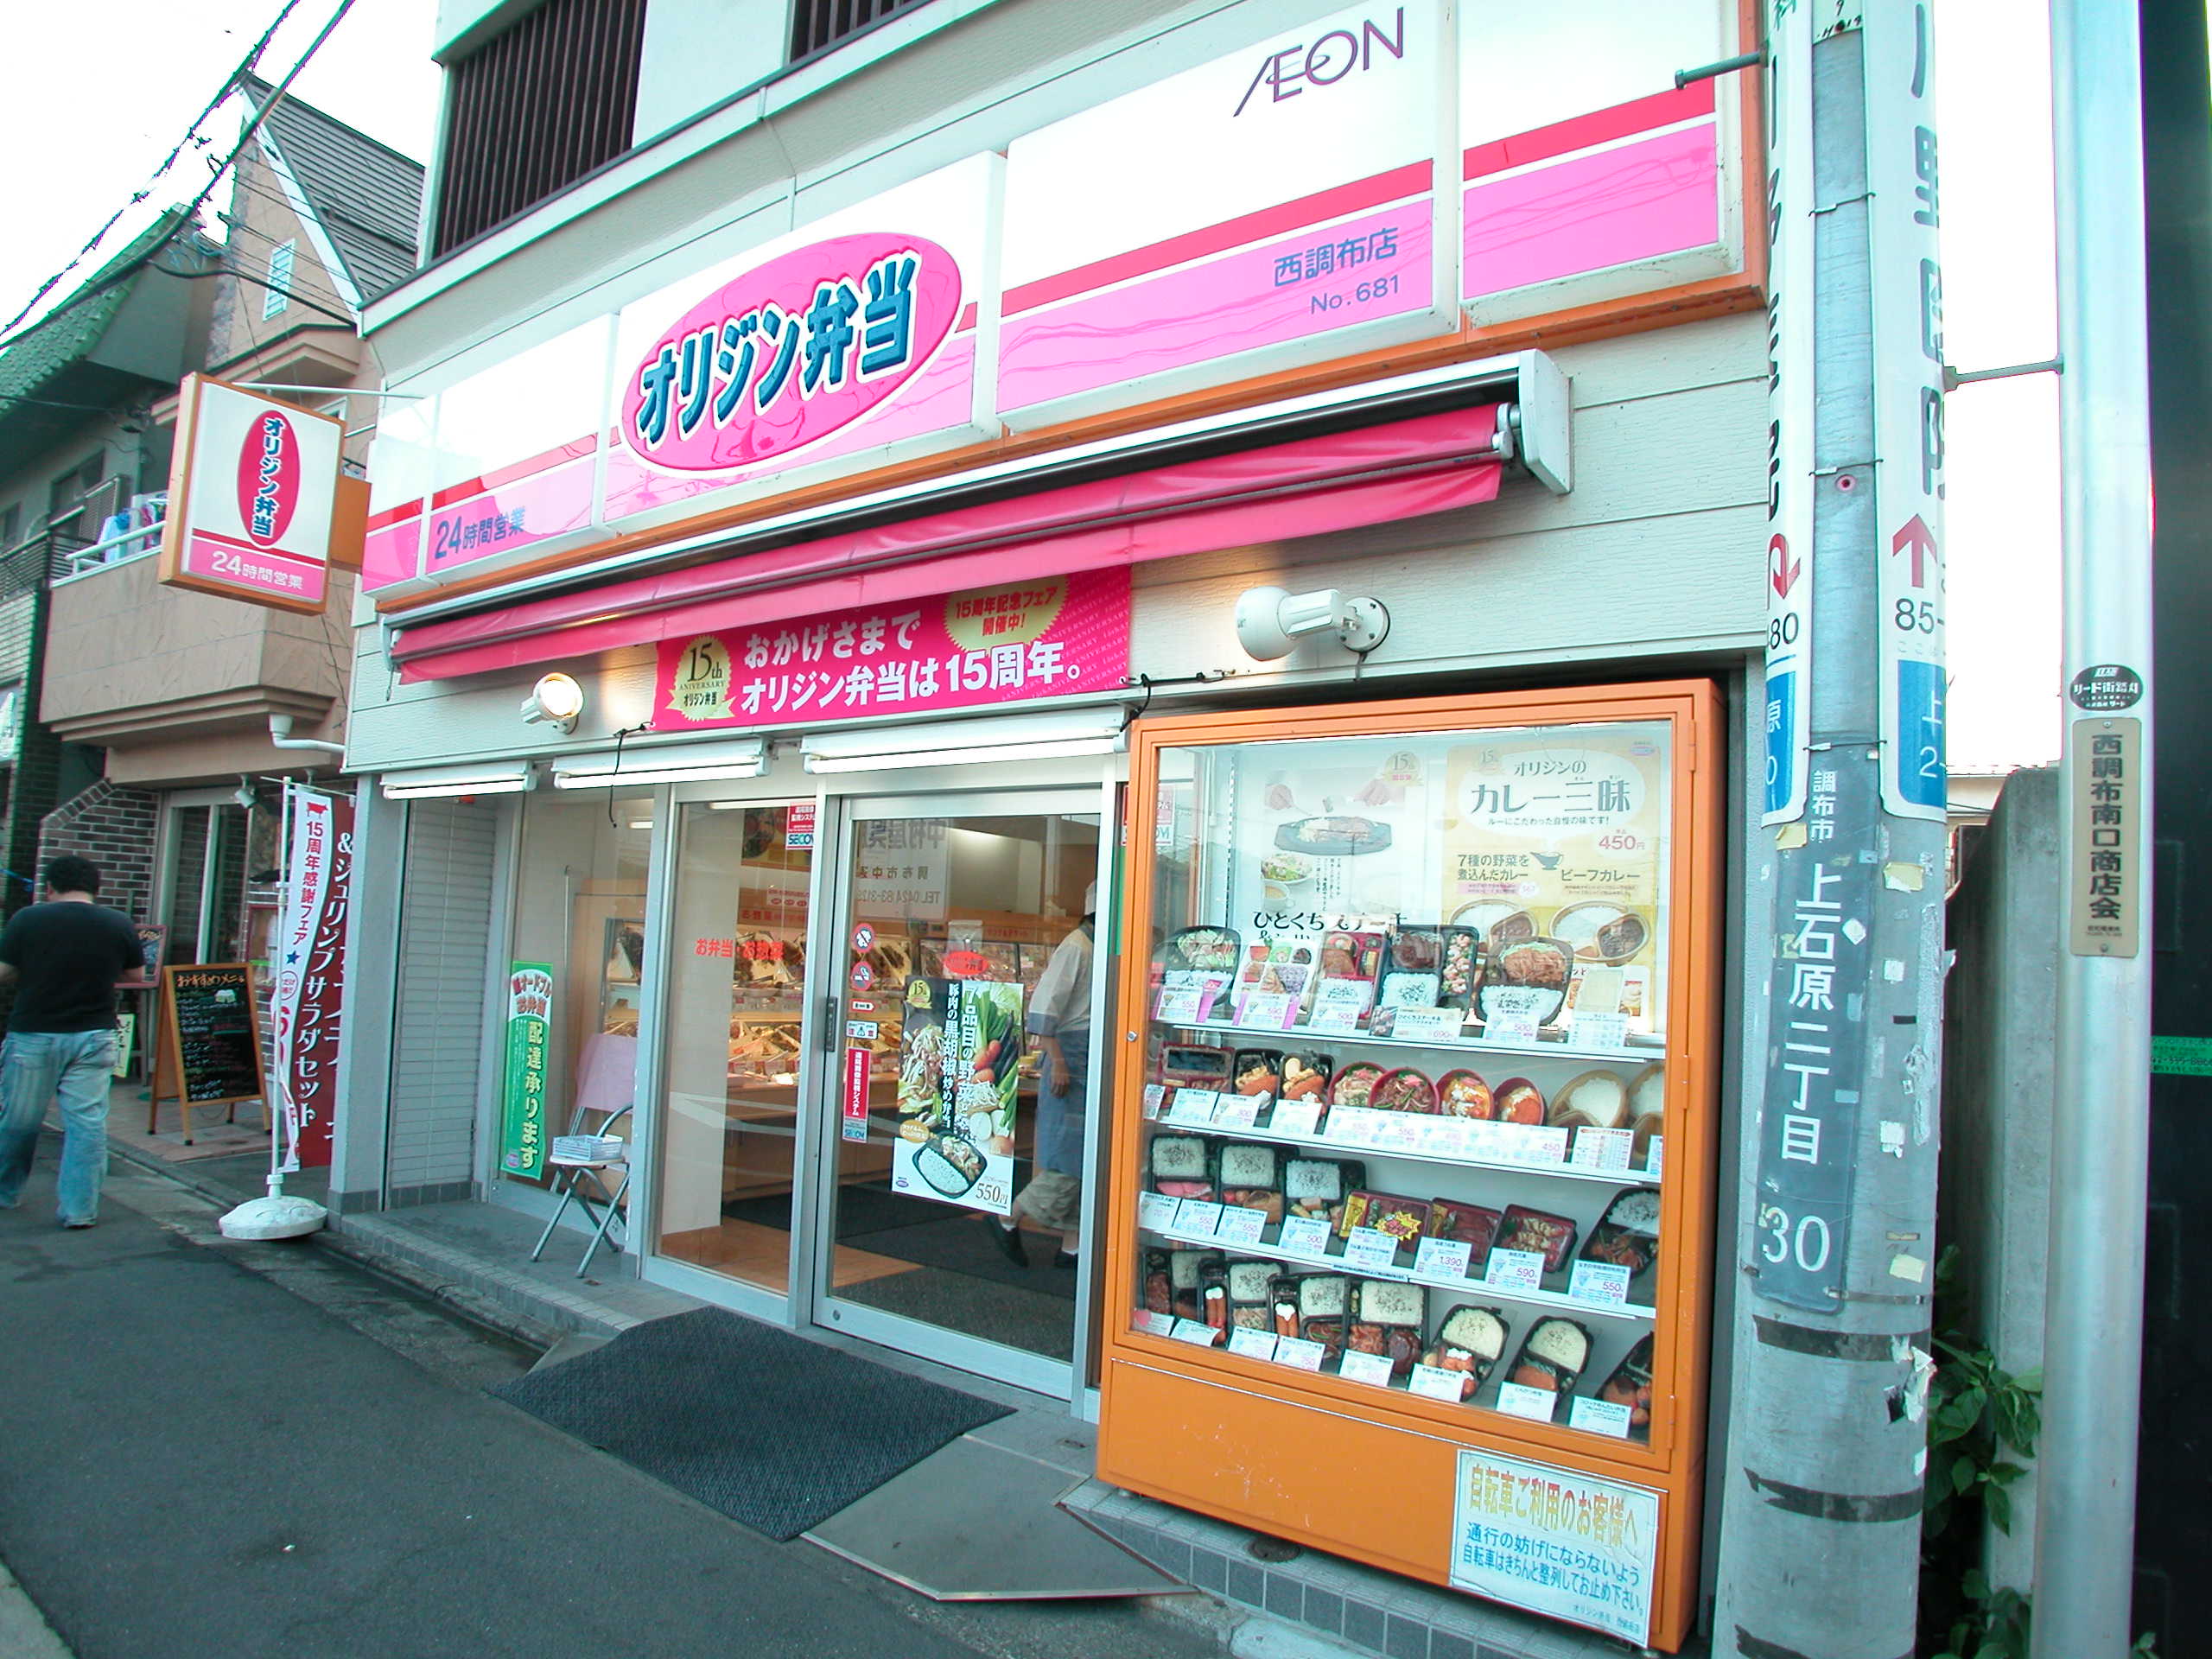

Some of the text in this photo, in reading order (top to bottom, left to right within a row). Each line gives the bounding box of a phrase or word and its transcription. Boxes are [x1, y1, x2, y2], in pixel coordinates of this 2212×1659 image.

[1274, 227, 1398, 287] 西調布店
[638, 257, 917, 445] オリジン弁当
[252, 417, 285, 537] オリジン弁当
[435, 506, 526, 559] 24時間営業
[211, 550, 303, 590] 24時間営業
[956, 586, 1058, 620] 15周年記念フェア
[744, 611, 921, 668] おかげさまで
[741, 641, 1081, 715] オリジン弁当は15周年。
[1471, 779, 1631, 815] カレー三昧
[1514, 760, 1586, 776] オリジンの
[1811, 770, 1837, 842] 調布市
[2089, 734, 2123, 919] 西調布南口商店会
[1459, 854, 1529, 868] 7種の野菜を
[1599, 835, 1645, 850] 450円
[293, 822, 323, 945] 15周年感謝フェア
[1458, 868, 1529, 881] 煮込んだカレー
[1560, 868, 1640, 882] ビーフカレー
[1781, 863, 1842, 1164] 上石原二丁目
[519, 1020, 543, 1169] 配達承ります
[1758, 1210, 1830, 1272] 30
[1470, 1463, 1639, 1548] 自転車ご利用のお客様へ
[1463, 1543, 1644, 1617] 自転車はきちんと整列してお止め下さい。
[1466, 1521, 1640, 1587] 通行の妨げにならないよう
